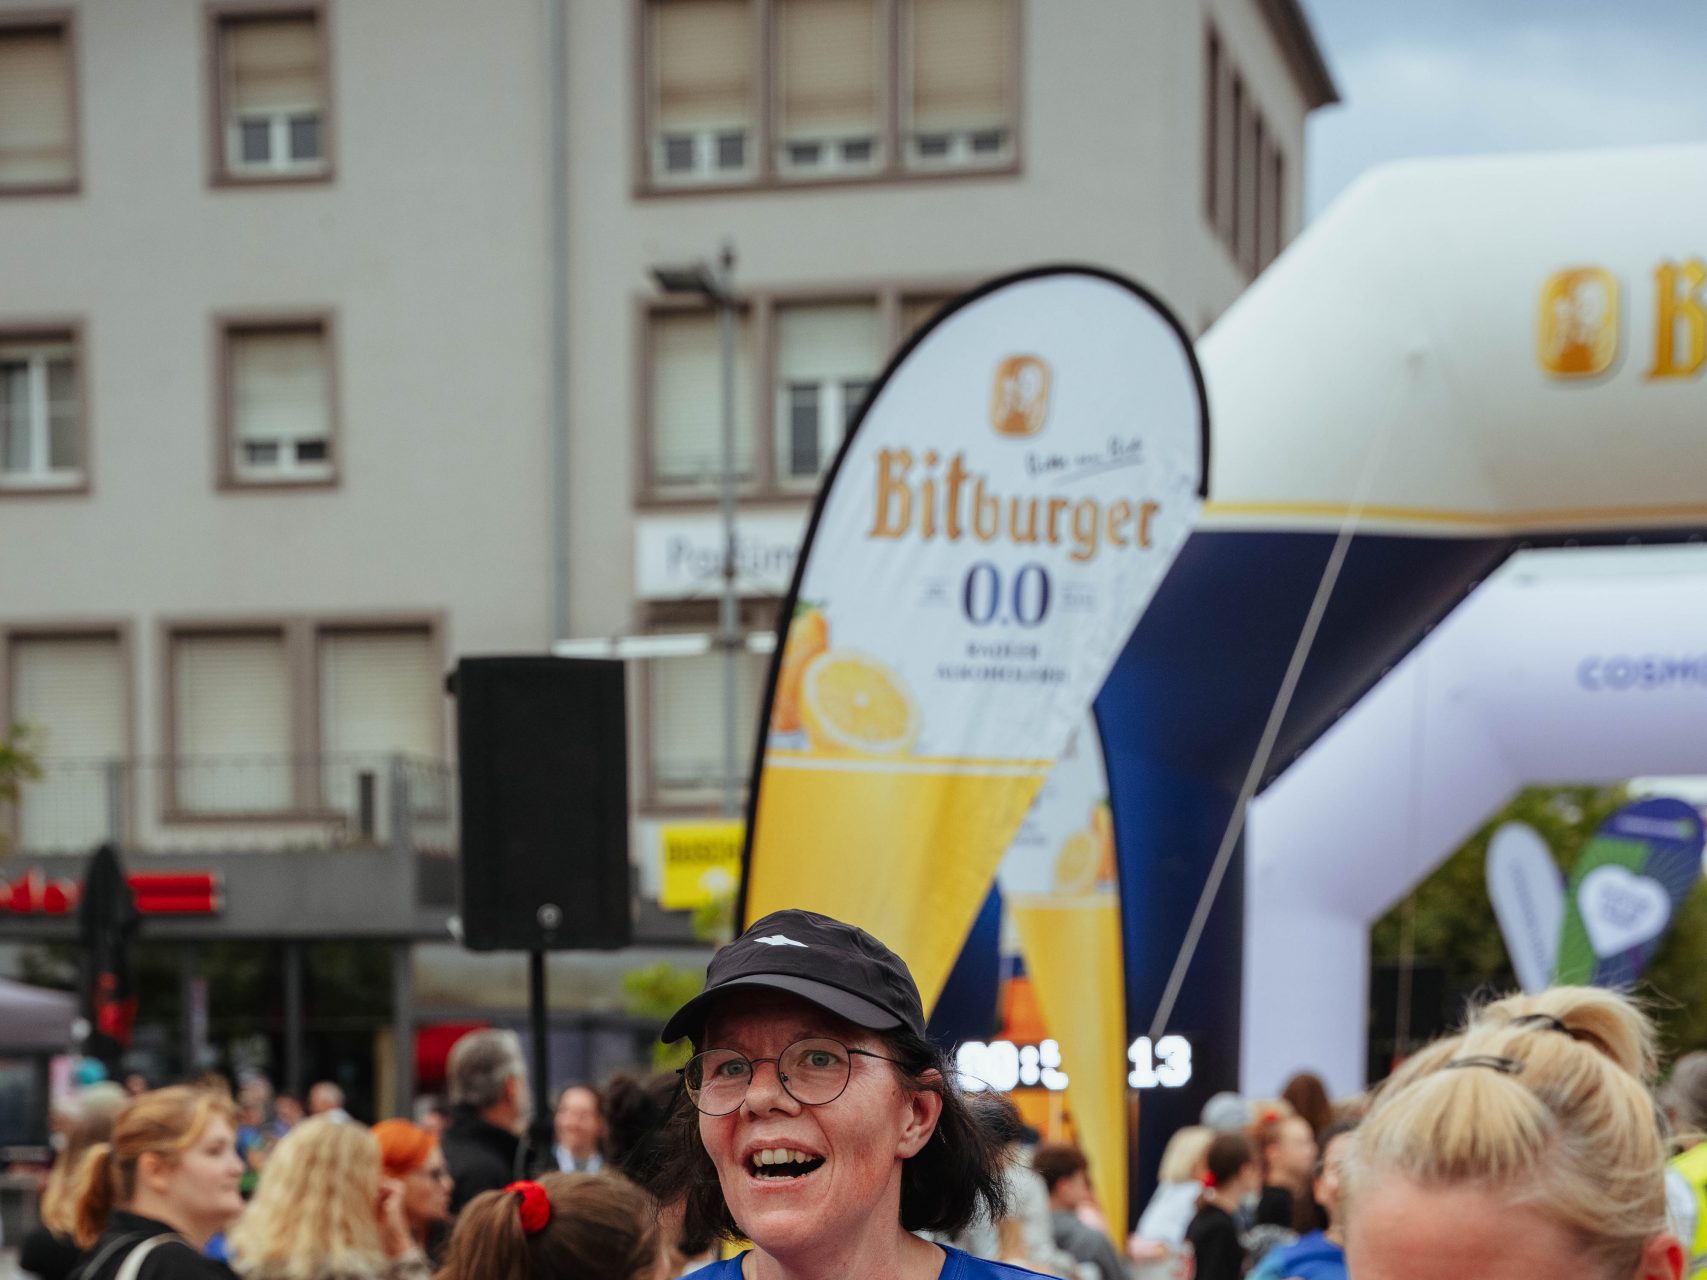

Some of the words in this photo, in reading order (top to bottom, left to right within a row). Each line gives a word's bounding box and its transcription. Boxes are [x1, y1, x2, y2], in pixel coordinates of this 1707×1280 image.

[868, 447, 1160, 563] Bitburger
[962, 560, 1052, 627] 0.0
[1576, 655, 1707, 691] COSM
[1128, 1035, 1192, 1088] 13
